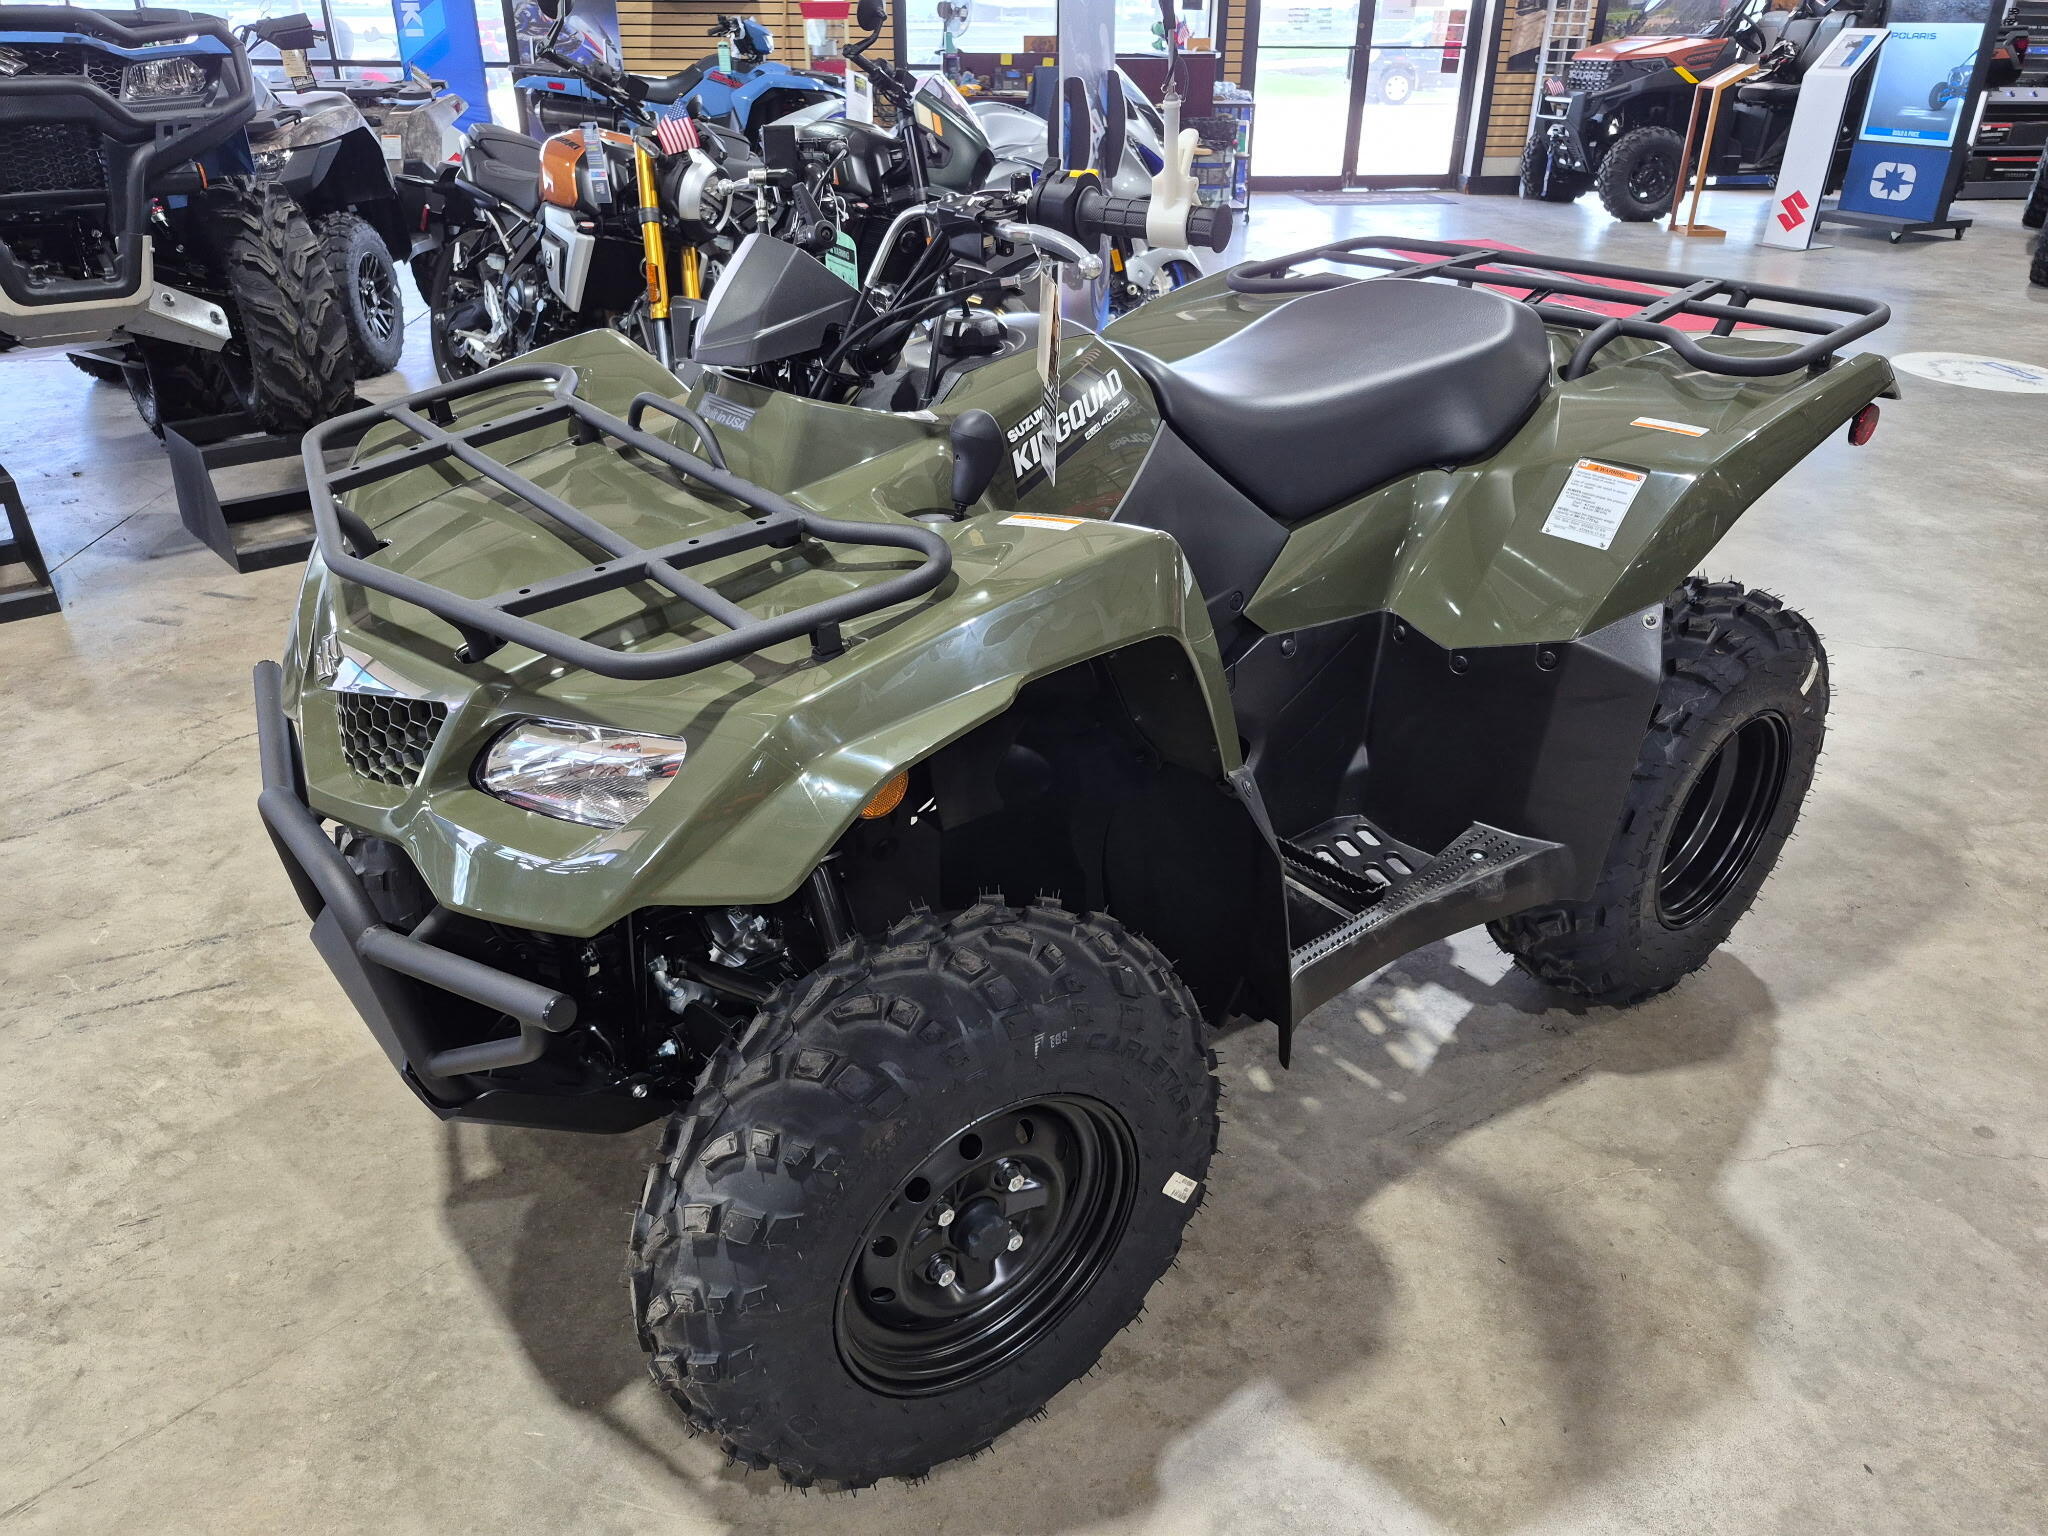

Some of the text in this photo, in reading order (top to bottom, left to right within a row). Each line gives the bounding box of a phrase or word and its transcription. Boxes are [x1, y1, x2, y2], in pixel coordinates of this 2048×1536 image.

[400, 0, 424, 37] KI
[1891, 32, 1937, 40] POLARIS
[726, 416, 747, 432] USA
[1012, 368, 1123, 479] KIGQUAD
